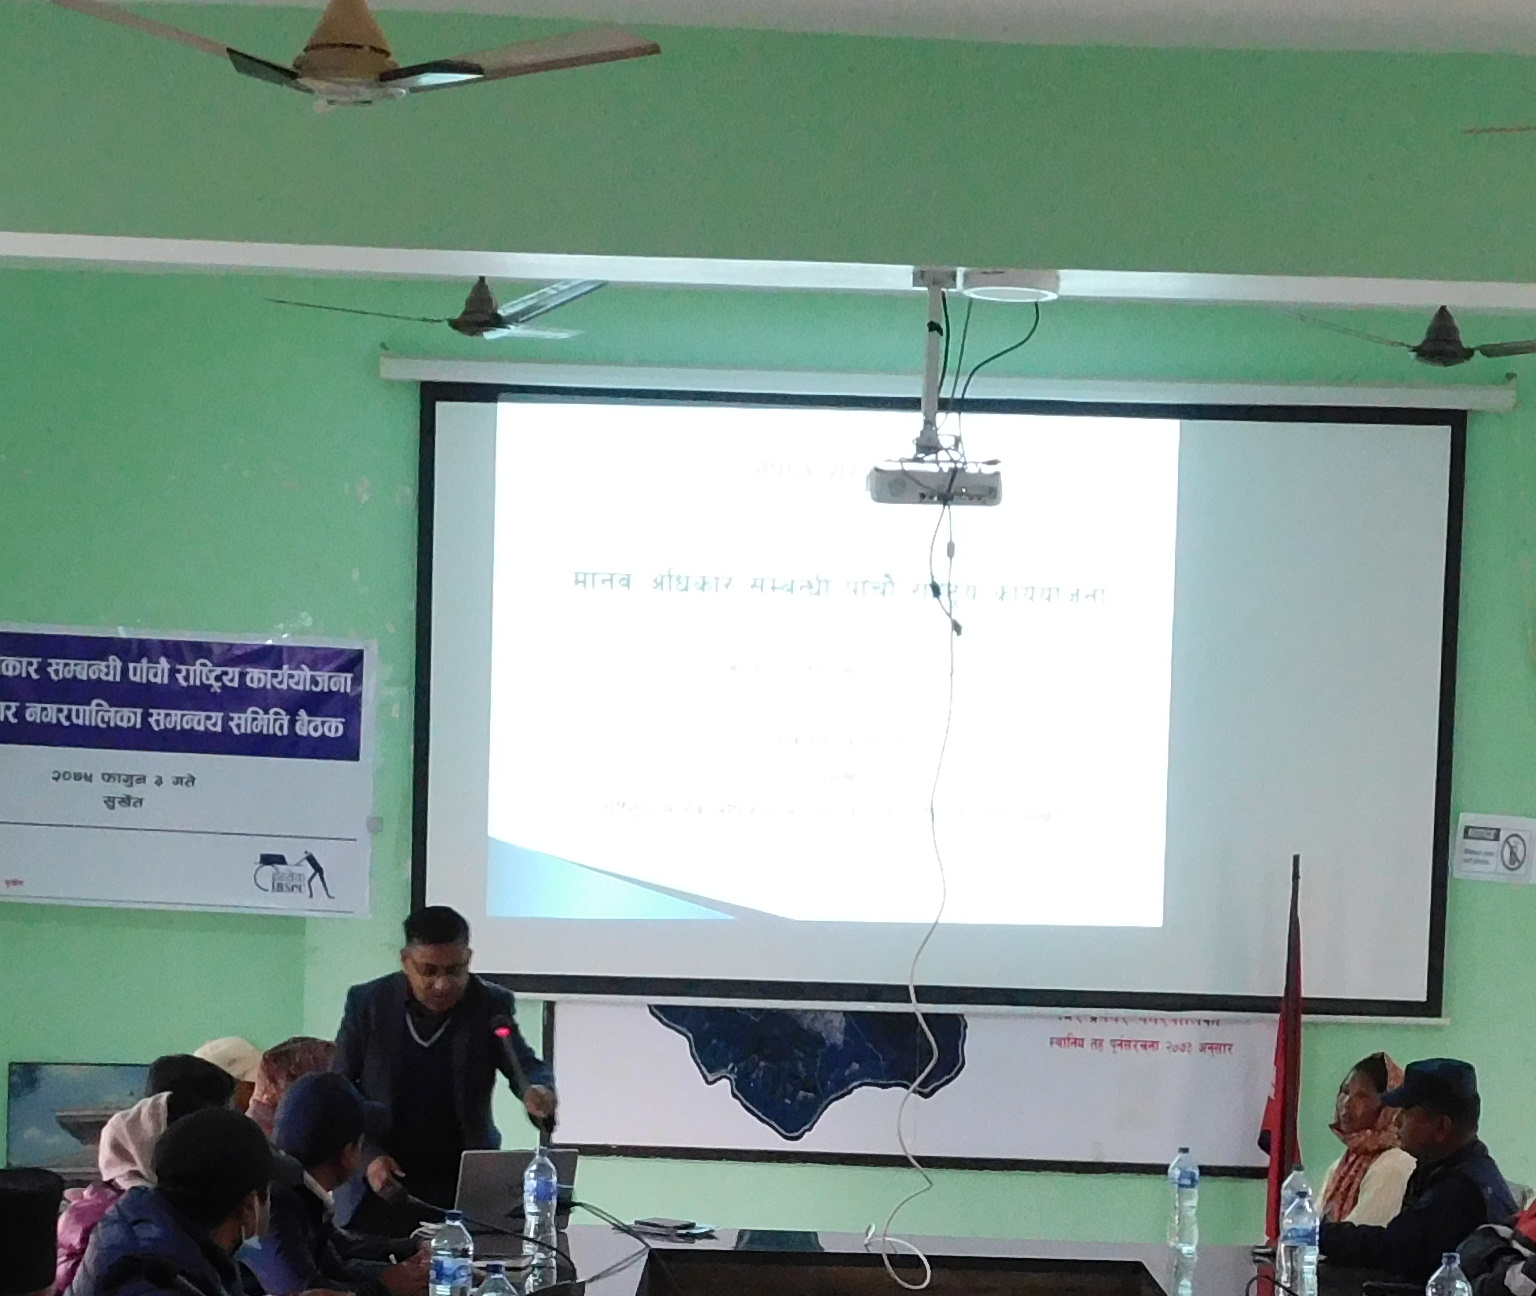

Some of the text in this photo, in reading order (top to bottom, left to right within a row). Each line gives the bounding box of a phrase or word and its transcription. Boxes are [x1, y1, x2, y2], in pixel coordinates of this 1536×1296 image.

[573, 571, 632, 591] मानव
[46, 655, 123, 682] सम्बन्धी
[175, 659, 242, 693] राष्ट्रिय
[245, 664, 353, 693] कार्ययोजना
[25, 698, 143, 729] नगरपालिका
[147, 708, 224, 733] समन्वय
[228, 706, 290, 736] समिति
[294, 709, 346, 738] बैठक
[101, 772, 147, 787] फागुन
[171, 773, 196, 787] गते
